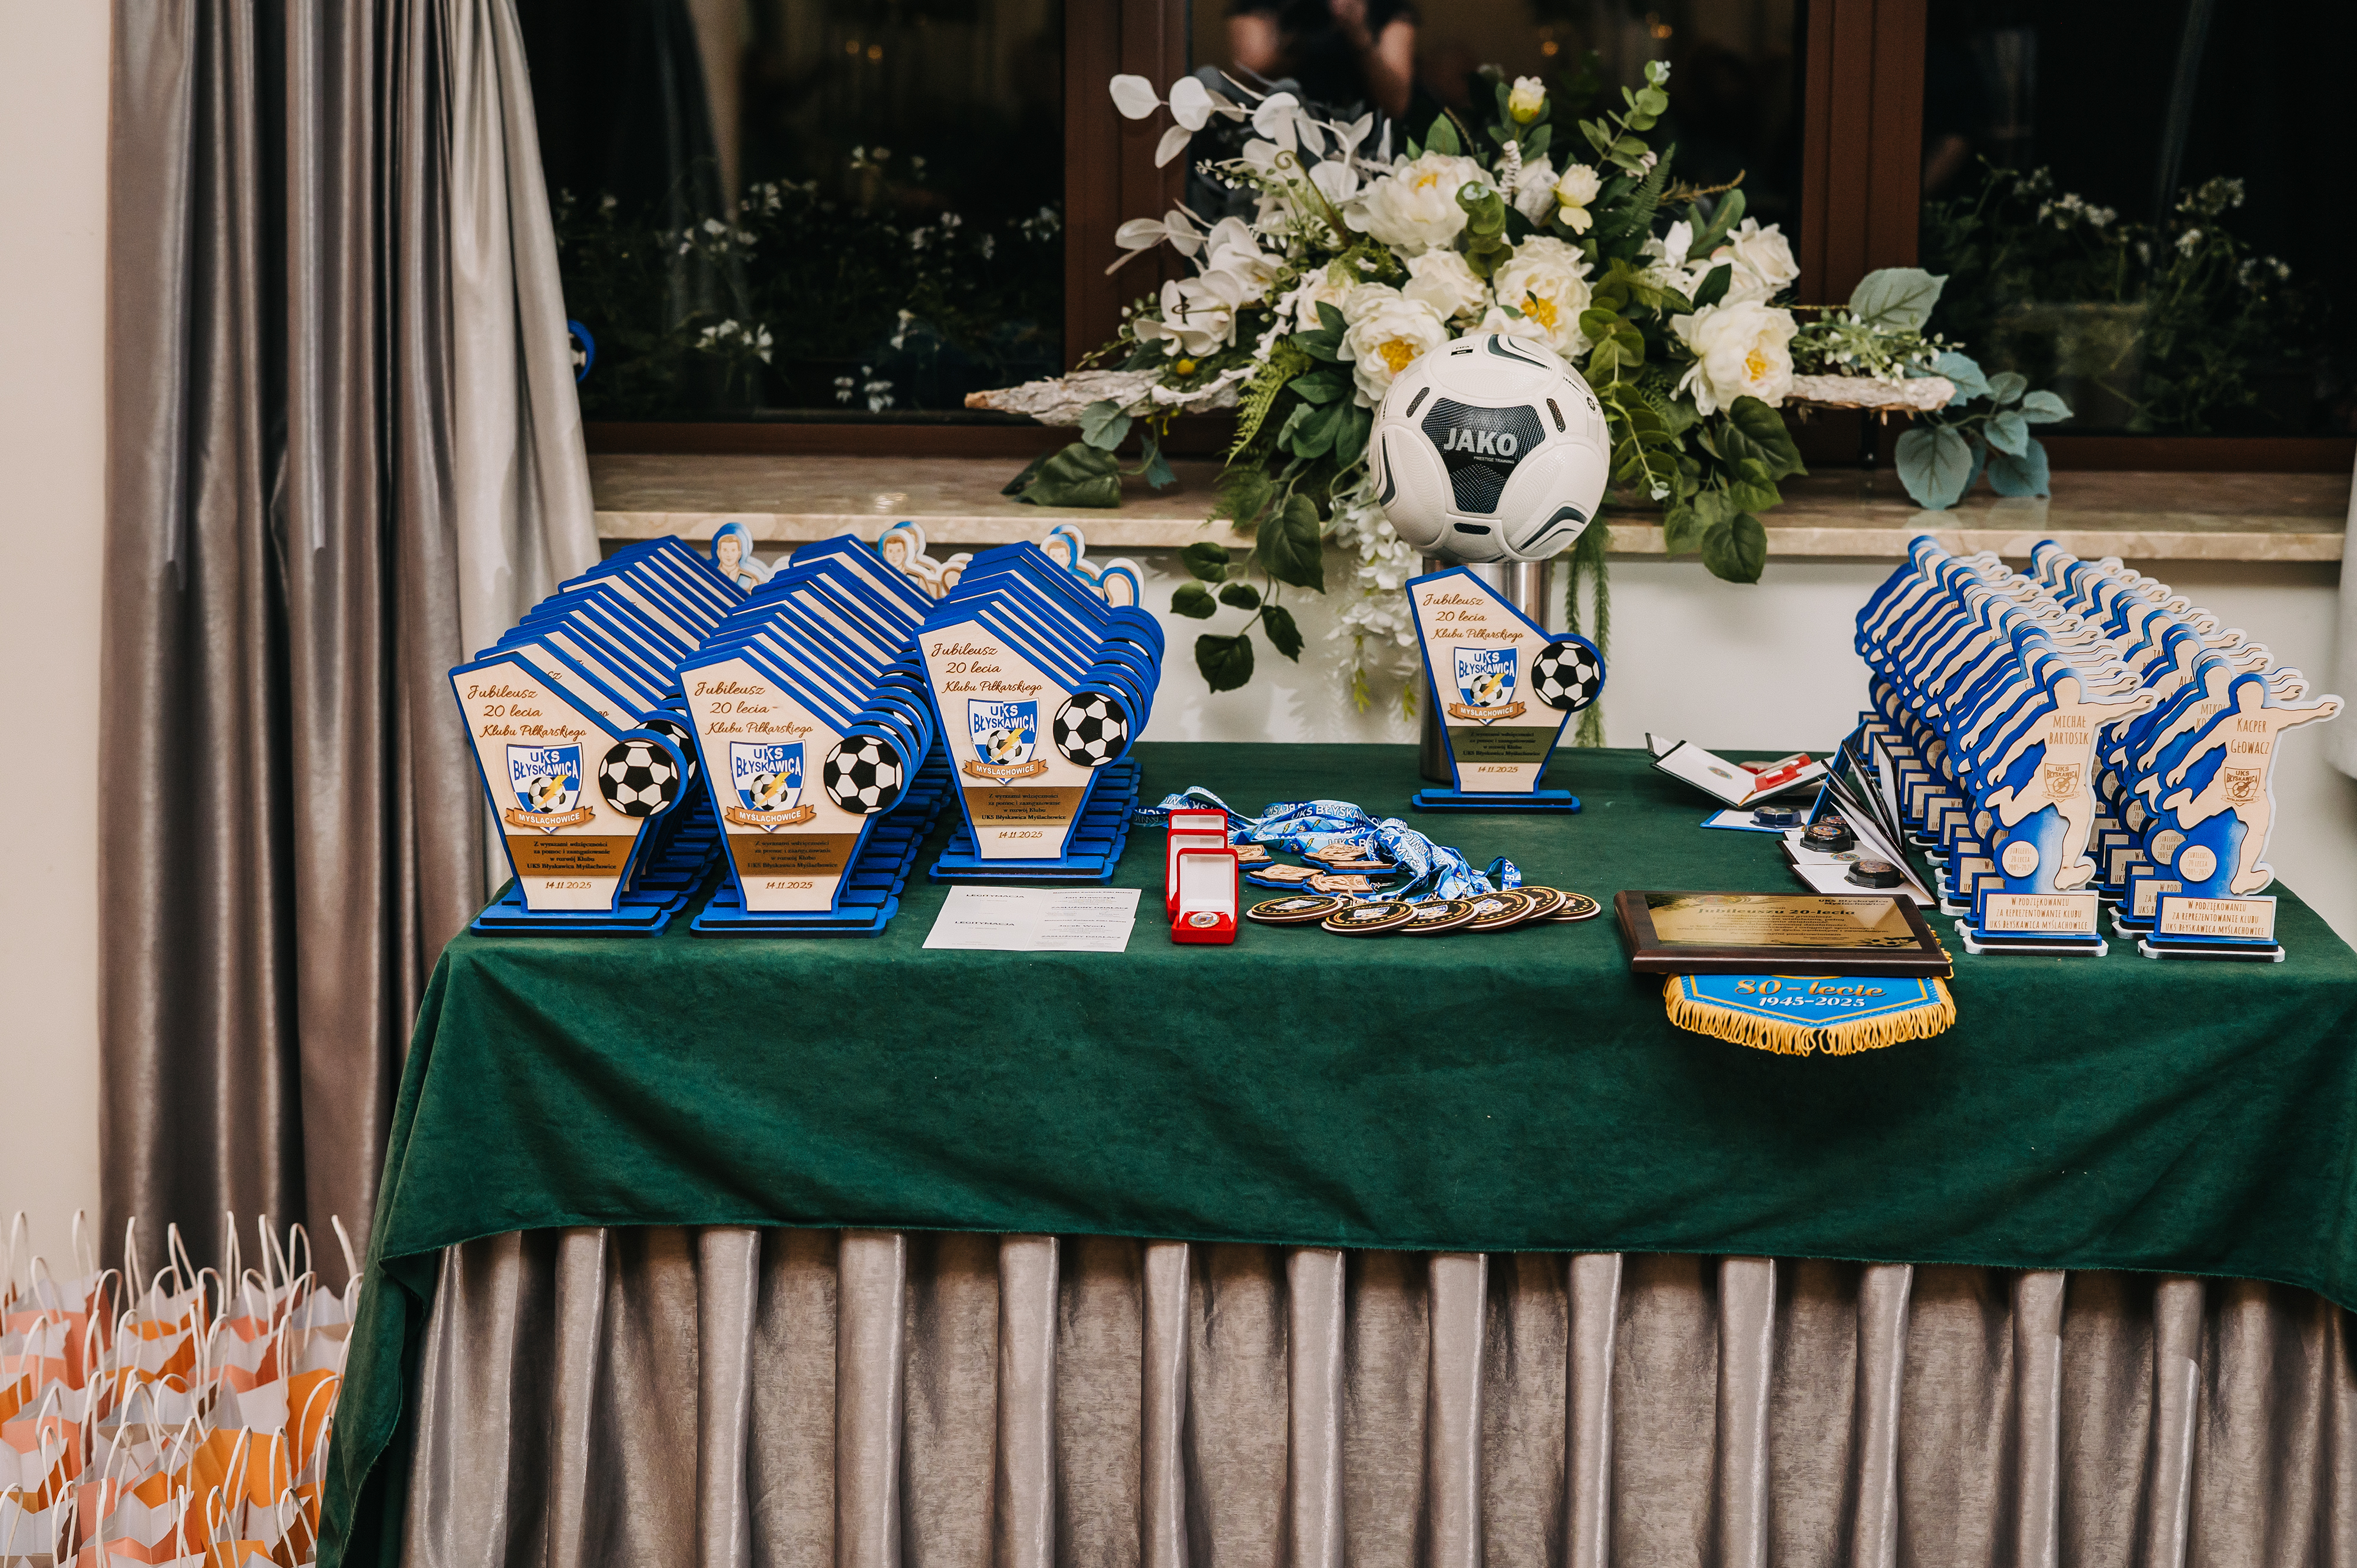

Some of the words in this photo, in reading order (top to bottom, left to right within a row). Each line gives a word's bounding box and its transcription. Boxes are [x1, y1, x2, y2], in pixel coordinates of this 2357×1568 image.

[1444, 428, 1517, 457] JAKO
[1423, 593, 1484, 606] Jubileusz
[1435, 611, 1455, 622] 20
[1458, 610, 1487, 622] lecia
[1431, 628, 1464, 640] Klubu
[1466, 628, 1524, 643] Piłkarskiego
[931, 643, 998, 657] Jubileusz
[1474, 652, 1500, 663] UKS
[946, 662, 966, 674] 20
[970, 661, 1002, 673] lecia
[1459, 659, 1515, 678] BŁYSKAWICA
[467, 685, 538, 699] Jubileusz
[694, 681, 765, 696] Jubileusz
[941, 681, 977, 694] Klubu
[979, 681, 1043, 696] Piłkarskiego
[483, 705, 505, 717] 20
[510, 704, 543, 717] lecia
[710, 702, 731, 714] 20
[737, 701, 770, 714] lecia
[991, 705, 1018, 718] UKS
[973, 712, 1035, 734] BŁYSKAWICA
[2053, 715, 2087, 728] MICHAŁ
[2237, 718, 2267, 733] KACPER
[479, 725, 517, 738] Klubu
[520, 725, 587, 742] Piłkarskiego
[705, 722, 744, 735] Klubu
[746, 721, 813, 738] Piłkarskiego
[2049, 732, 2089, 745] BARTOSIK
[2230, 739, 2270, 754] GŁOWACZ
[530, 751, 560, 764] UKS
[754, 747, 784, 761] UKS
[513, 760, 579, 781] BŁYSKAWICA
[736, 756, 801, 778] BŁYSKAWICA
[976, 764, 1034, 775] MYŚLACHOWICE
[2046, 770, 2077, 779] BŁYSKAWICA
[2227, 773, 2257, 783] BŁYSKAWICA
[519, 813, 580, 824] MYŚLACHOWICE
[740, 810, 801, 822] MYŚLACHOWICE
[1291, 806, 1313, 820] UKS
[1316, 804, 1367, 823] BŁYSKAW
[2011, 897, 2017, 906] W
[2018, 897, 2069, 908] PODZIĘKOWANIU
[2188, 900, 2194, 909] W
[2195, 902, 2247, 912] PODZIĘKOWANIU
[1996, 909, 2003, 917] ZA
[2006, 909, 2061, 917] REPREZENTOWANIE
[2063, 910, 2082, 918] KLUBU
[2172, 912, 2179, 920] ZA
[2181, 912, 2237, 923] REPREZENTOWANIE
[2240, 915, 2259, 924] KLUBU
[1990, 920, 2001, 928] UKS
[2003, 920, 2039, 929] BŁYSKAWICA
[2042, 919, 2088, 930] MYŚLACHOWICE
[2165, 923, 2177, 932] UKS
[2178, 923, 2216, 933] BŁYSKAWICA
[2217, 924, 2264, 935] MYŚLACHOWICE
[1759, 996, 1866, 1007] 1945-2025
